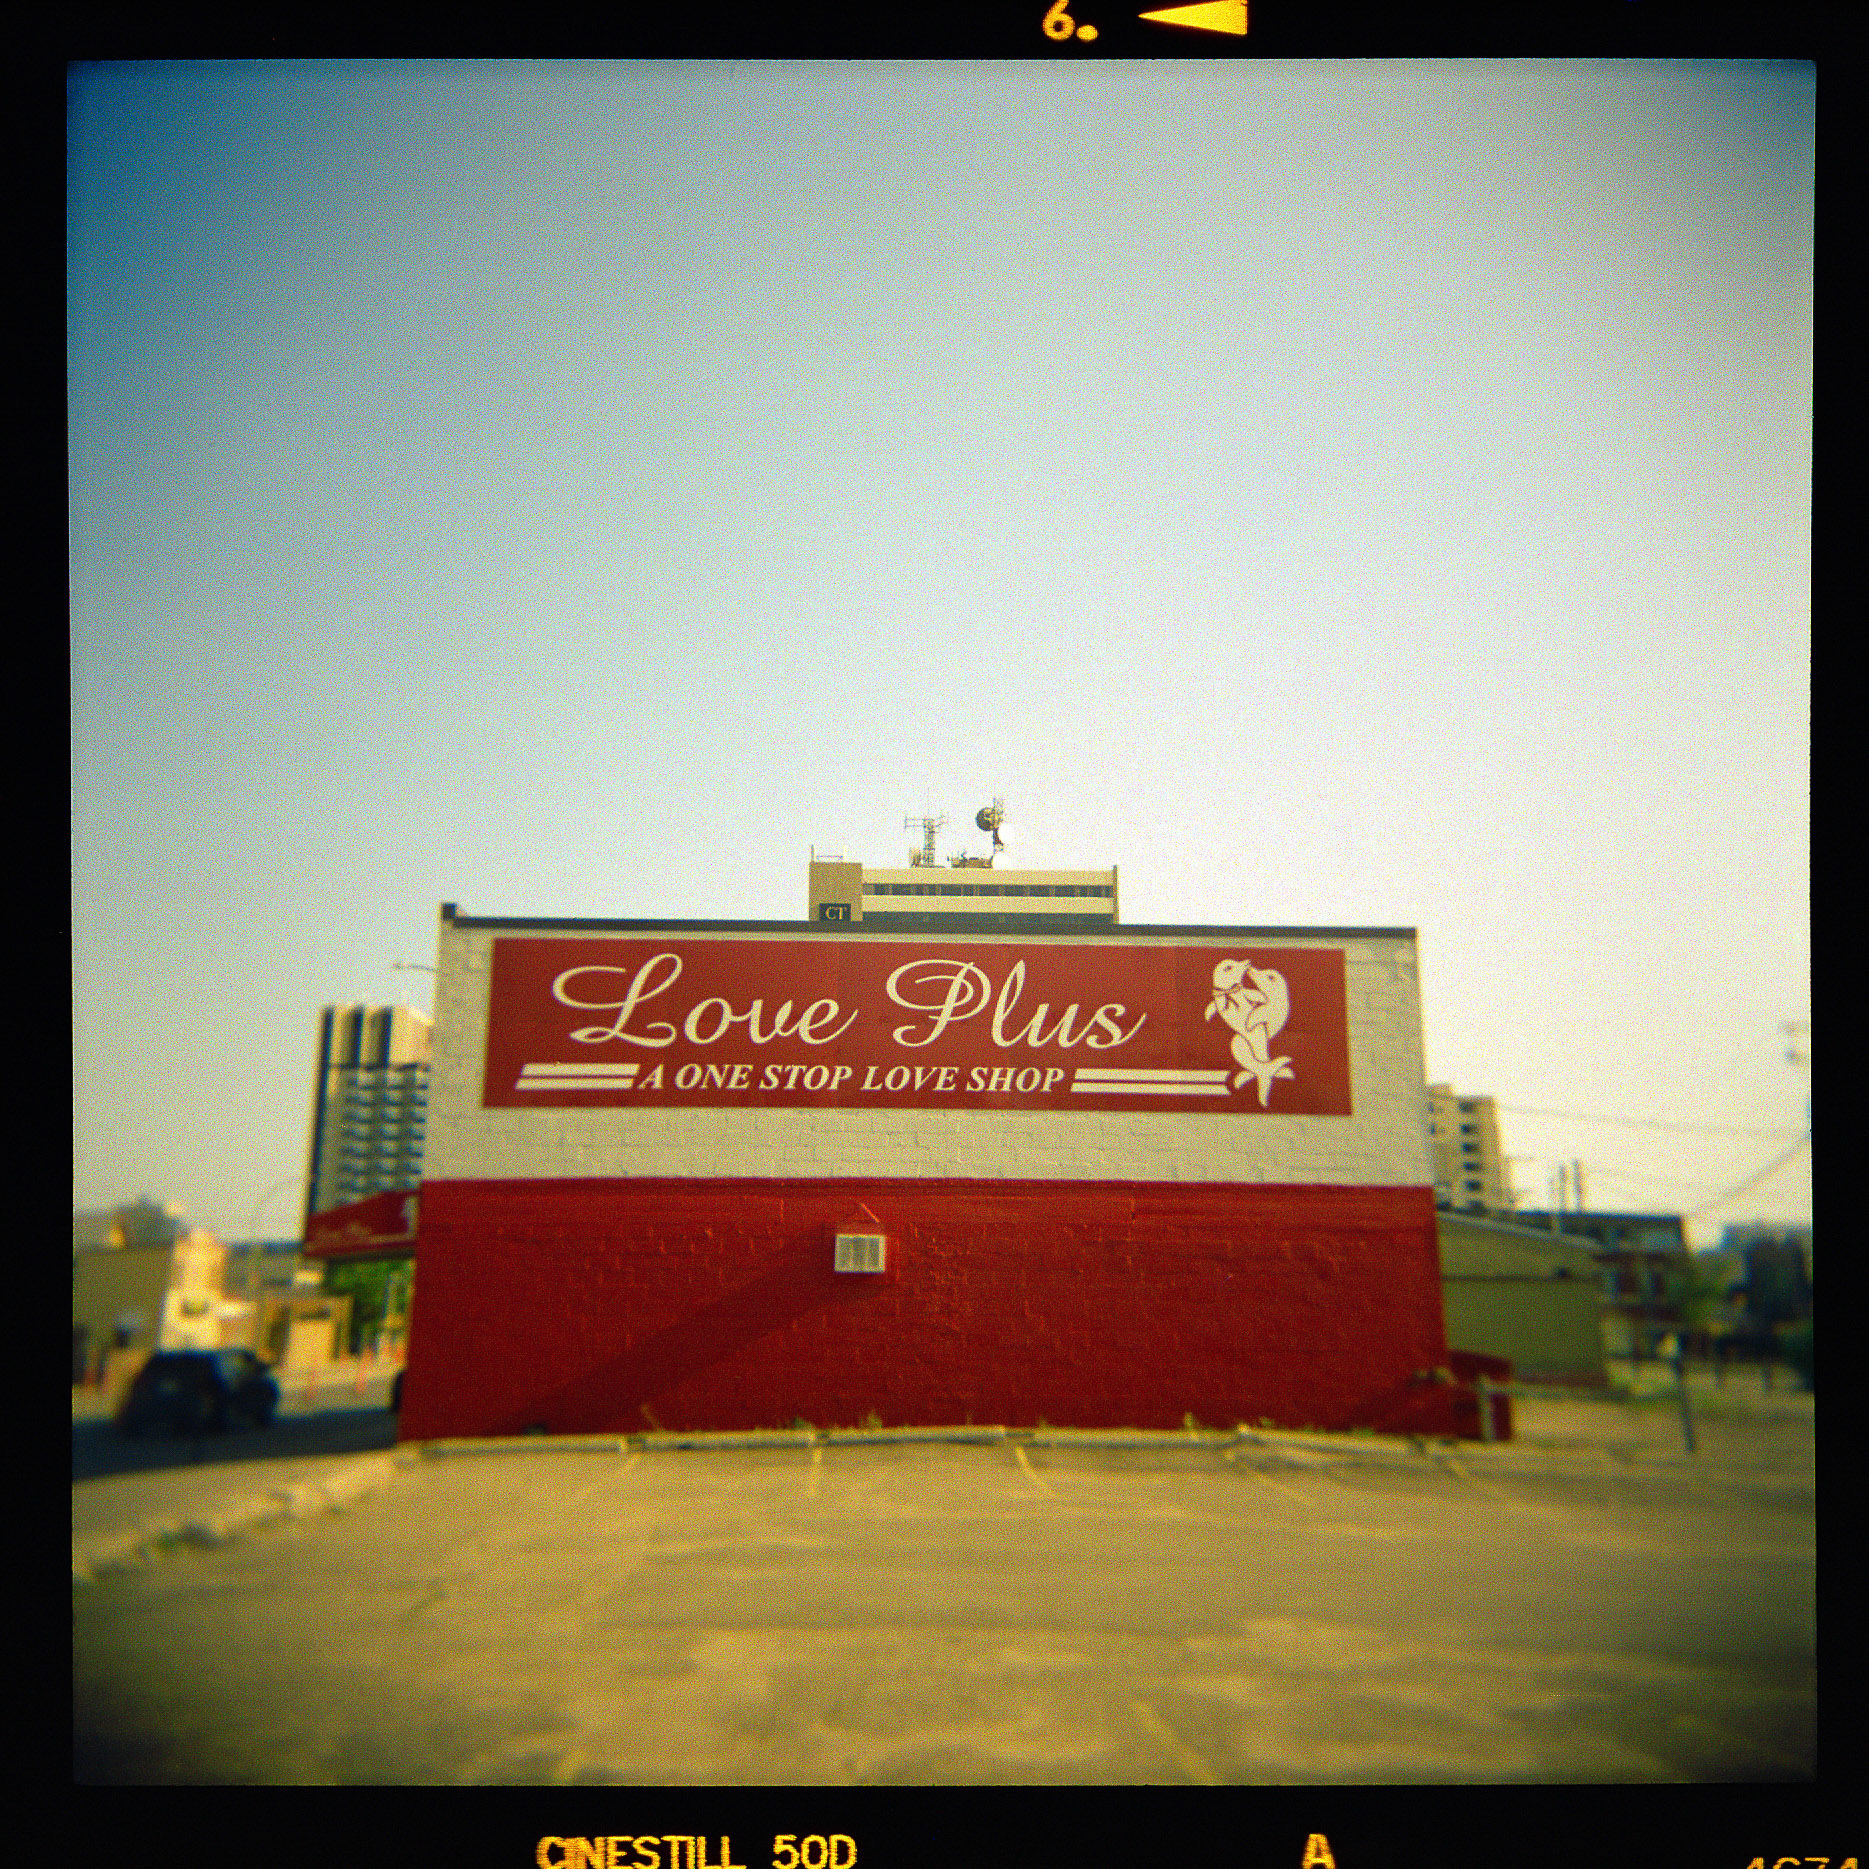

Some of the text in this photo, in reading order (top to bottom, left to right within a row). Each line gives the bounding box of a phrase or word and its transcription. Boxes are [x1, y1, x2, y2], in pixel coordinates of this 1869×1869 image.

[553, 953, 1147, 1049] Love Plus
[637, 1064, 1065, 1092] A ONE STOP LOVE SHOP
[772, 1834, 858, 1869] 50D
[1302, 1833, 1336, 1869] A
